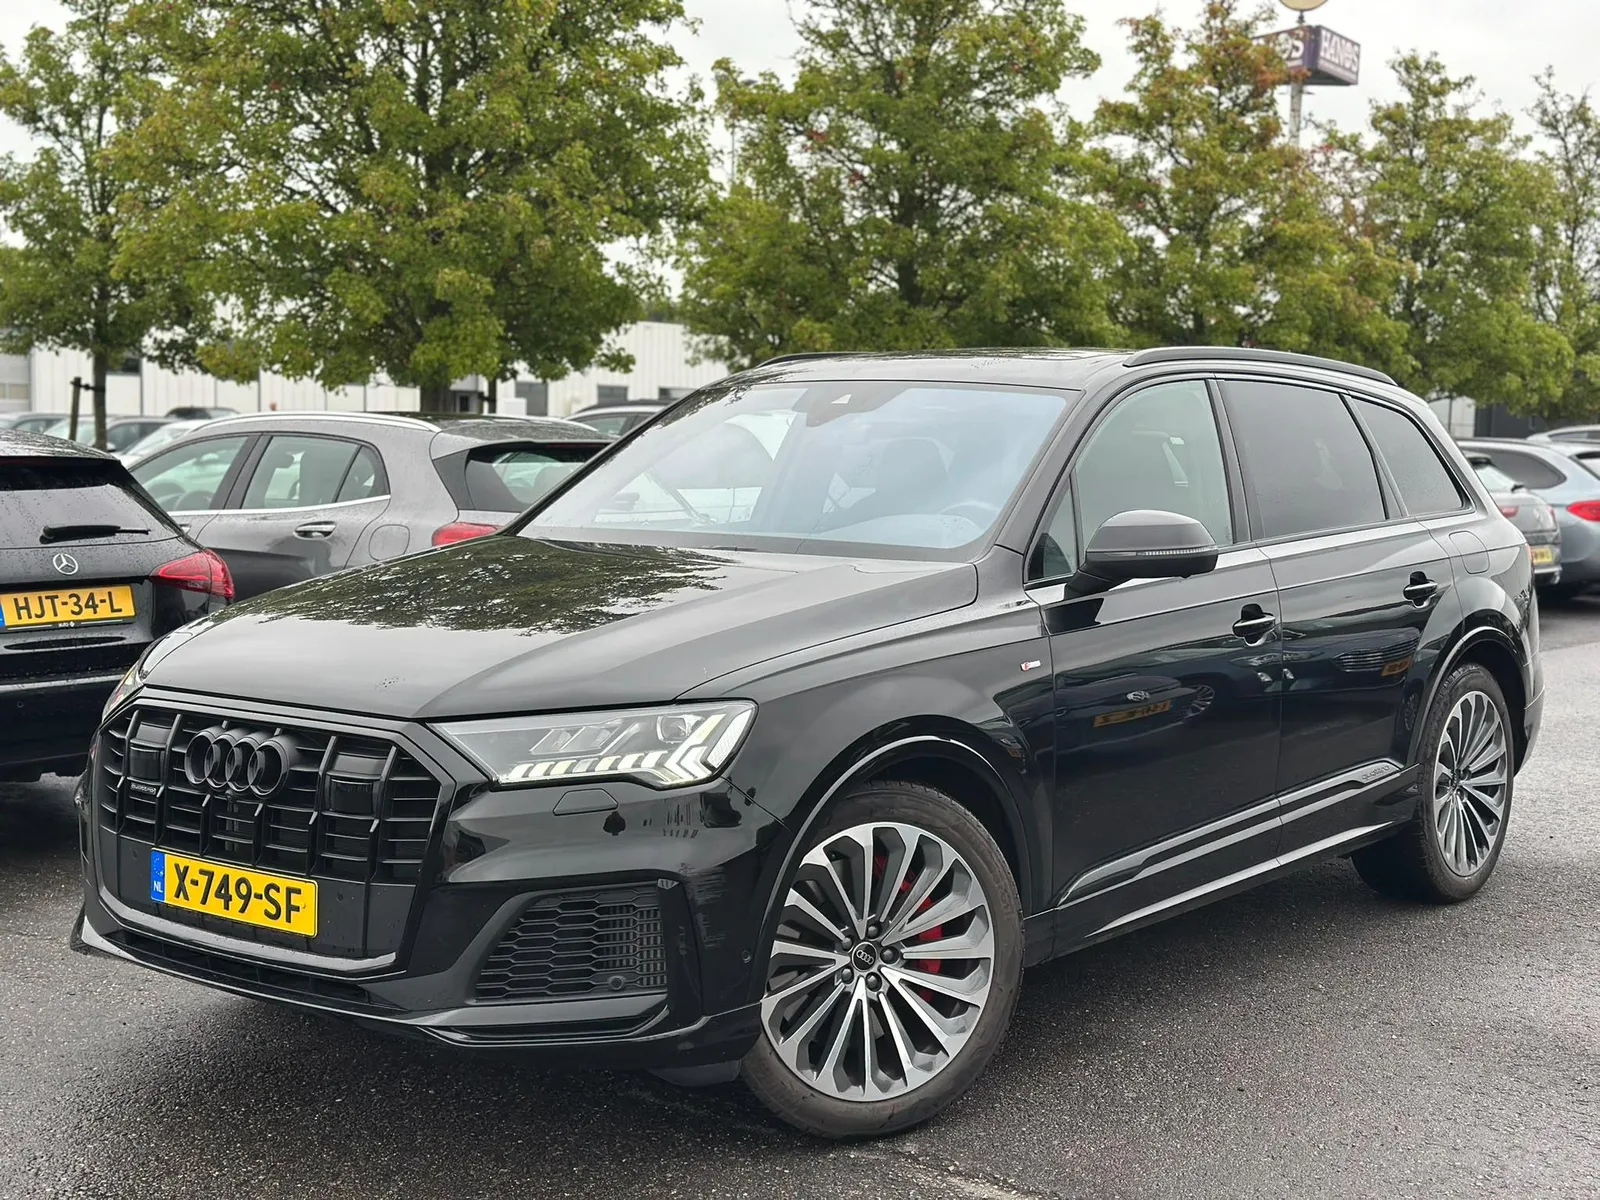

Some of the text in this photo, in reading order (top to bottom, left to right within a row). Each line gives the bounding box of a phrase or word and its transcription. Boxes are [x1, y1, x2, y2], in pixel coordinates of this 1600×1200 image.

[13, 591, 122, 620] HJT-34-L
[153, 880, 163, 894] NL
[173, 862, 302, 924] X-749-SF
